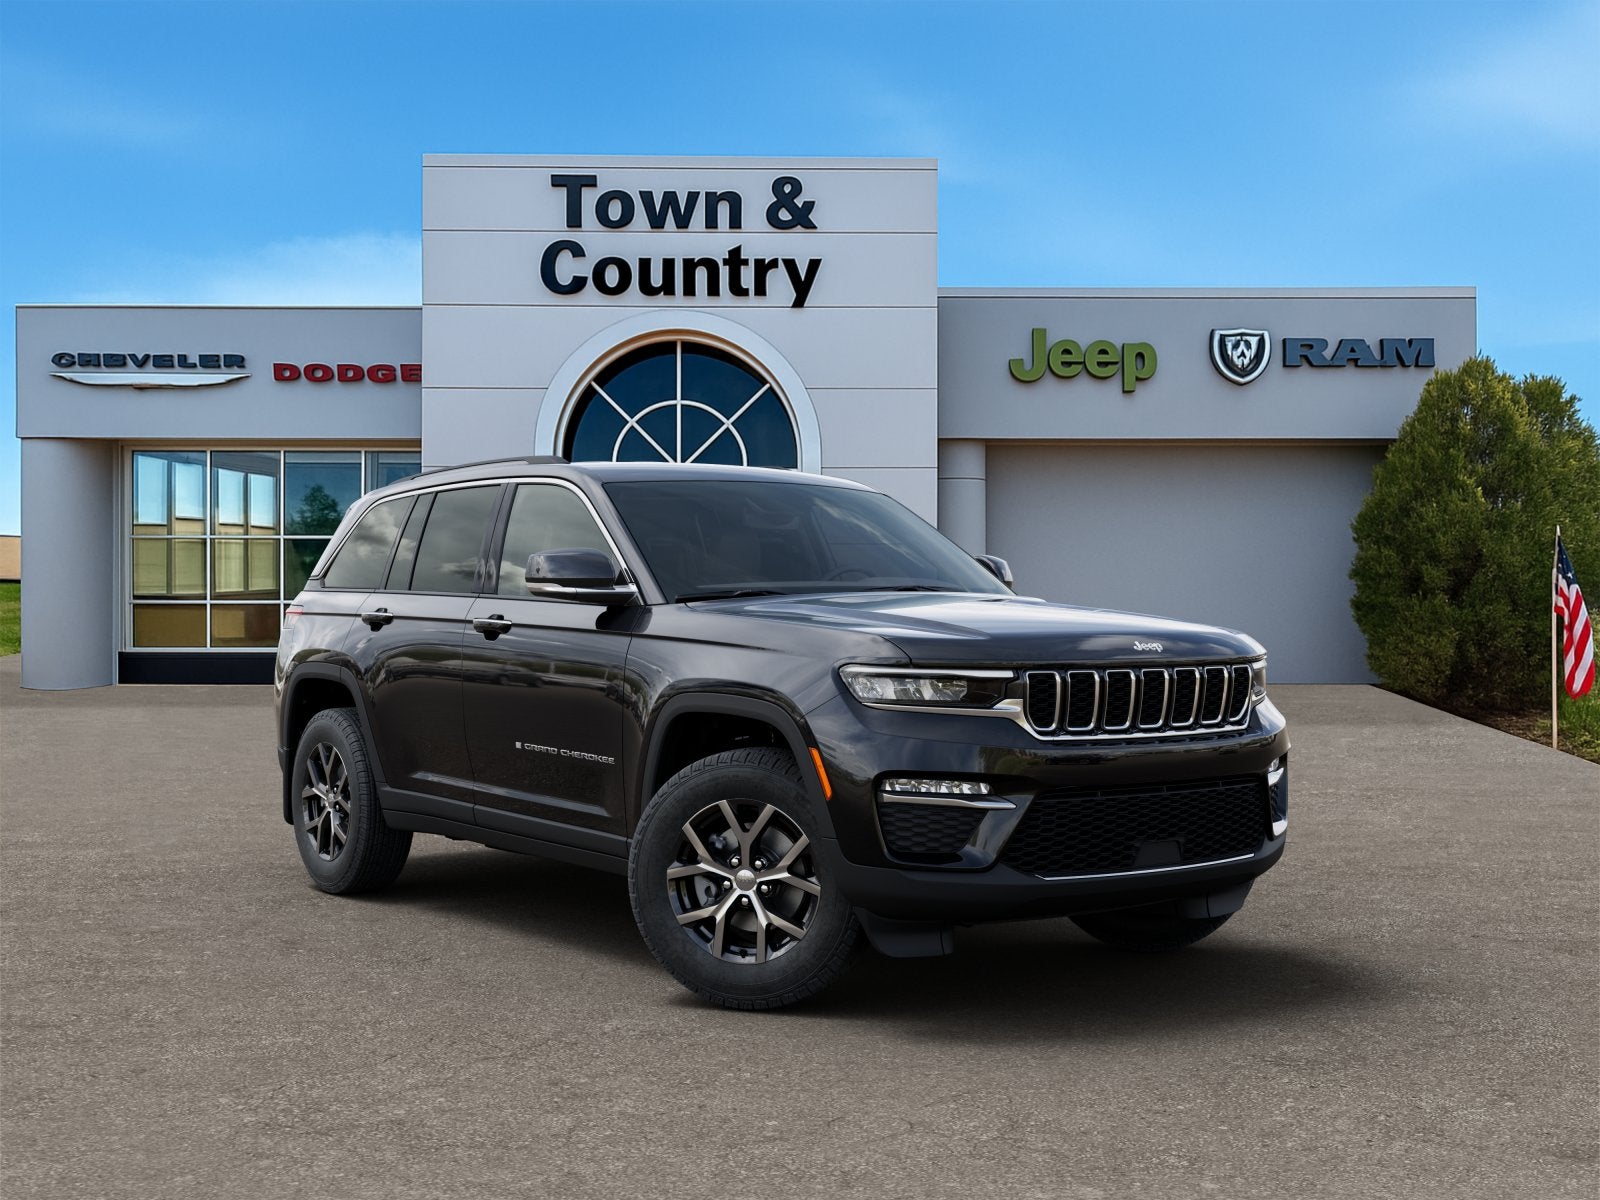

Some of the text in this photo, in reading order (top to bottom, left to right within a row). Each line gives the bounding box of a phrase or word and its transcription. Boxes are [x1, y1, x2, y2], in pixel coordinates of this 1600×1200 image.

[551, 174, 817, 229] Town &
[540, 239, 822, 308] Country
[1009, 328, 1157, 393] Jeep
[1283, 338, 1435, 368] RAM
[273, 362, 422, 383] DODGE
[1133, 640, 1164, 653] Jeep
[560, 749, 615, 765] CHEROKEE
